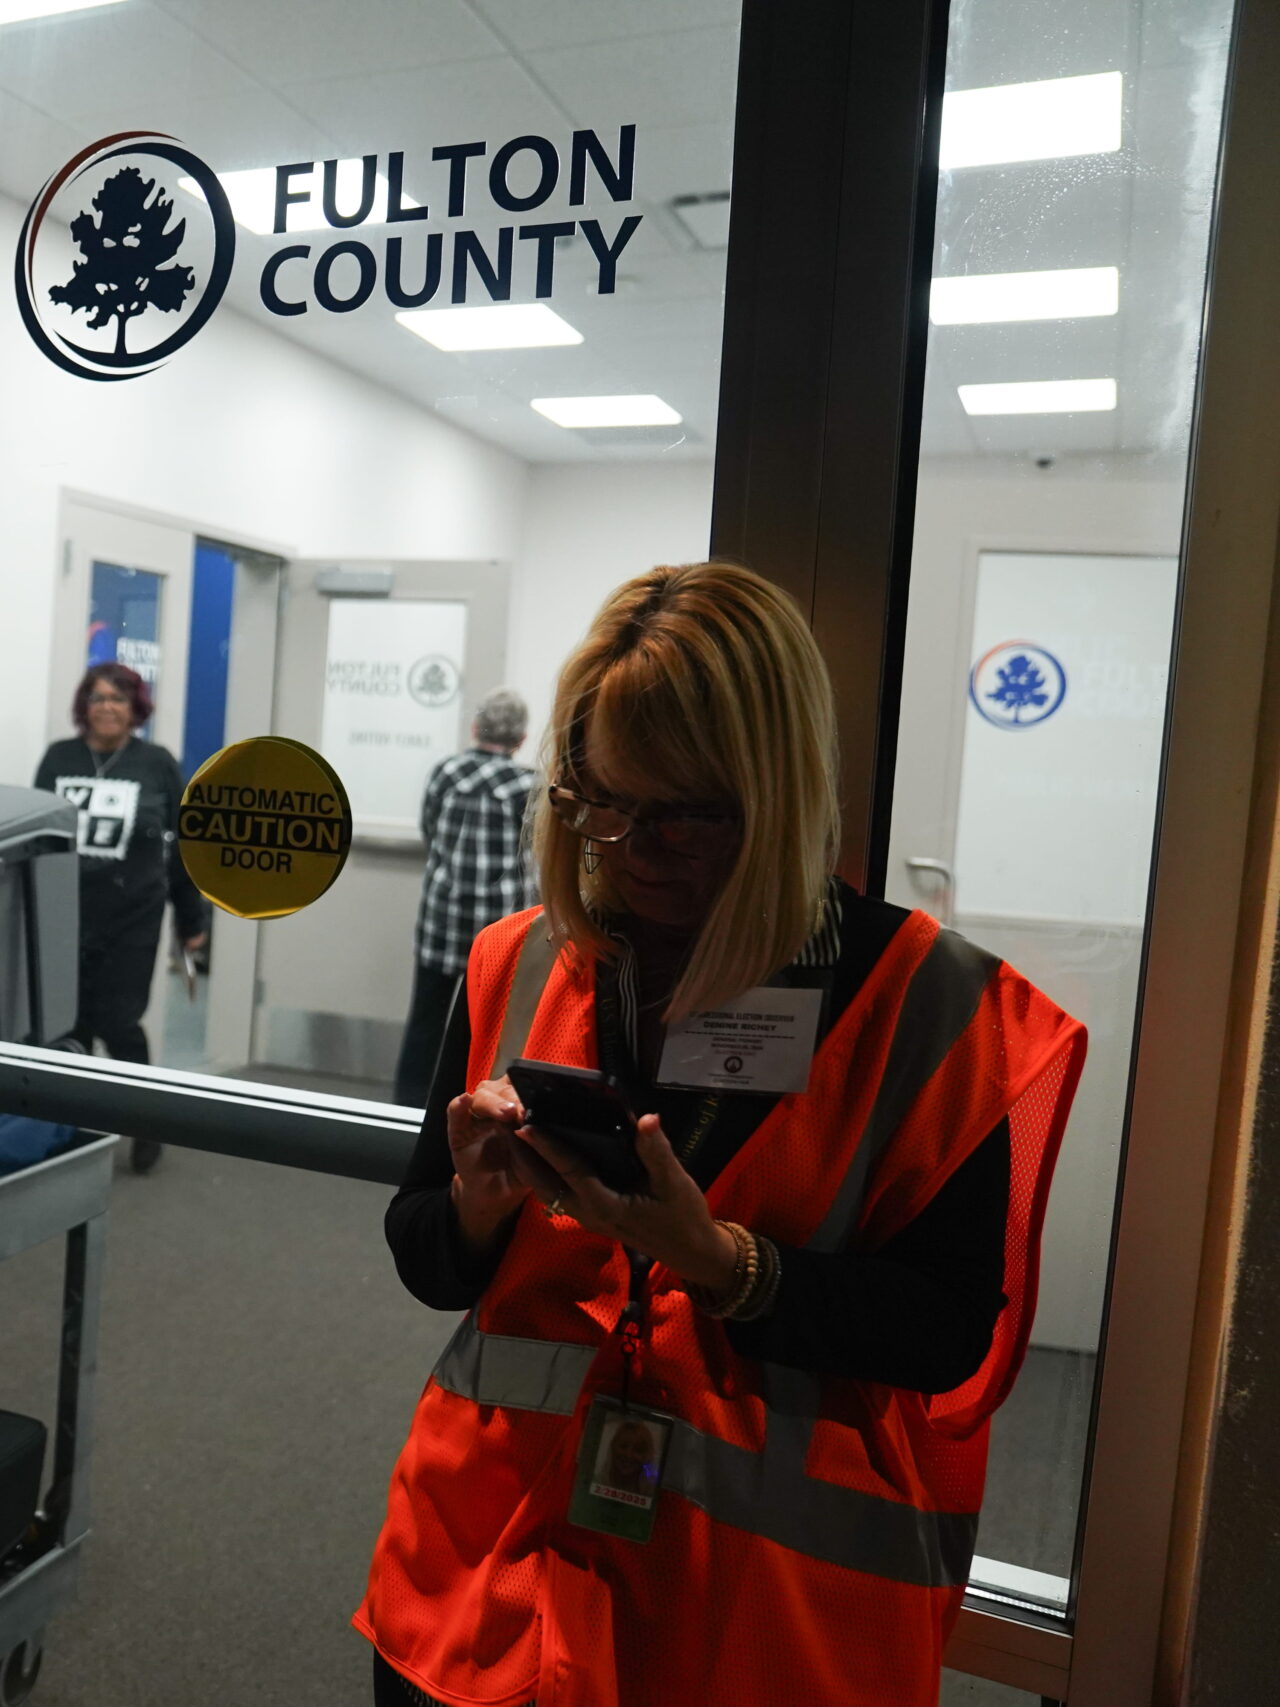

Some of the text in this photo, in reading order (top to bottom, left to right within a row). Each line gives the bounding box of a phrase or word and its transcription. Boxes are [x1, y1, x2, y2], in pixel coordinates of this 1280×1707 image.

[273, 123, 637, 234] FULTON
[259, 214, 645, 317] COUNTY
[189, 783, 336, 815] AUTOMATIC
[179, 810, 341, 850] CAUTION
[220, 847, 293, 873] DOOR
